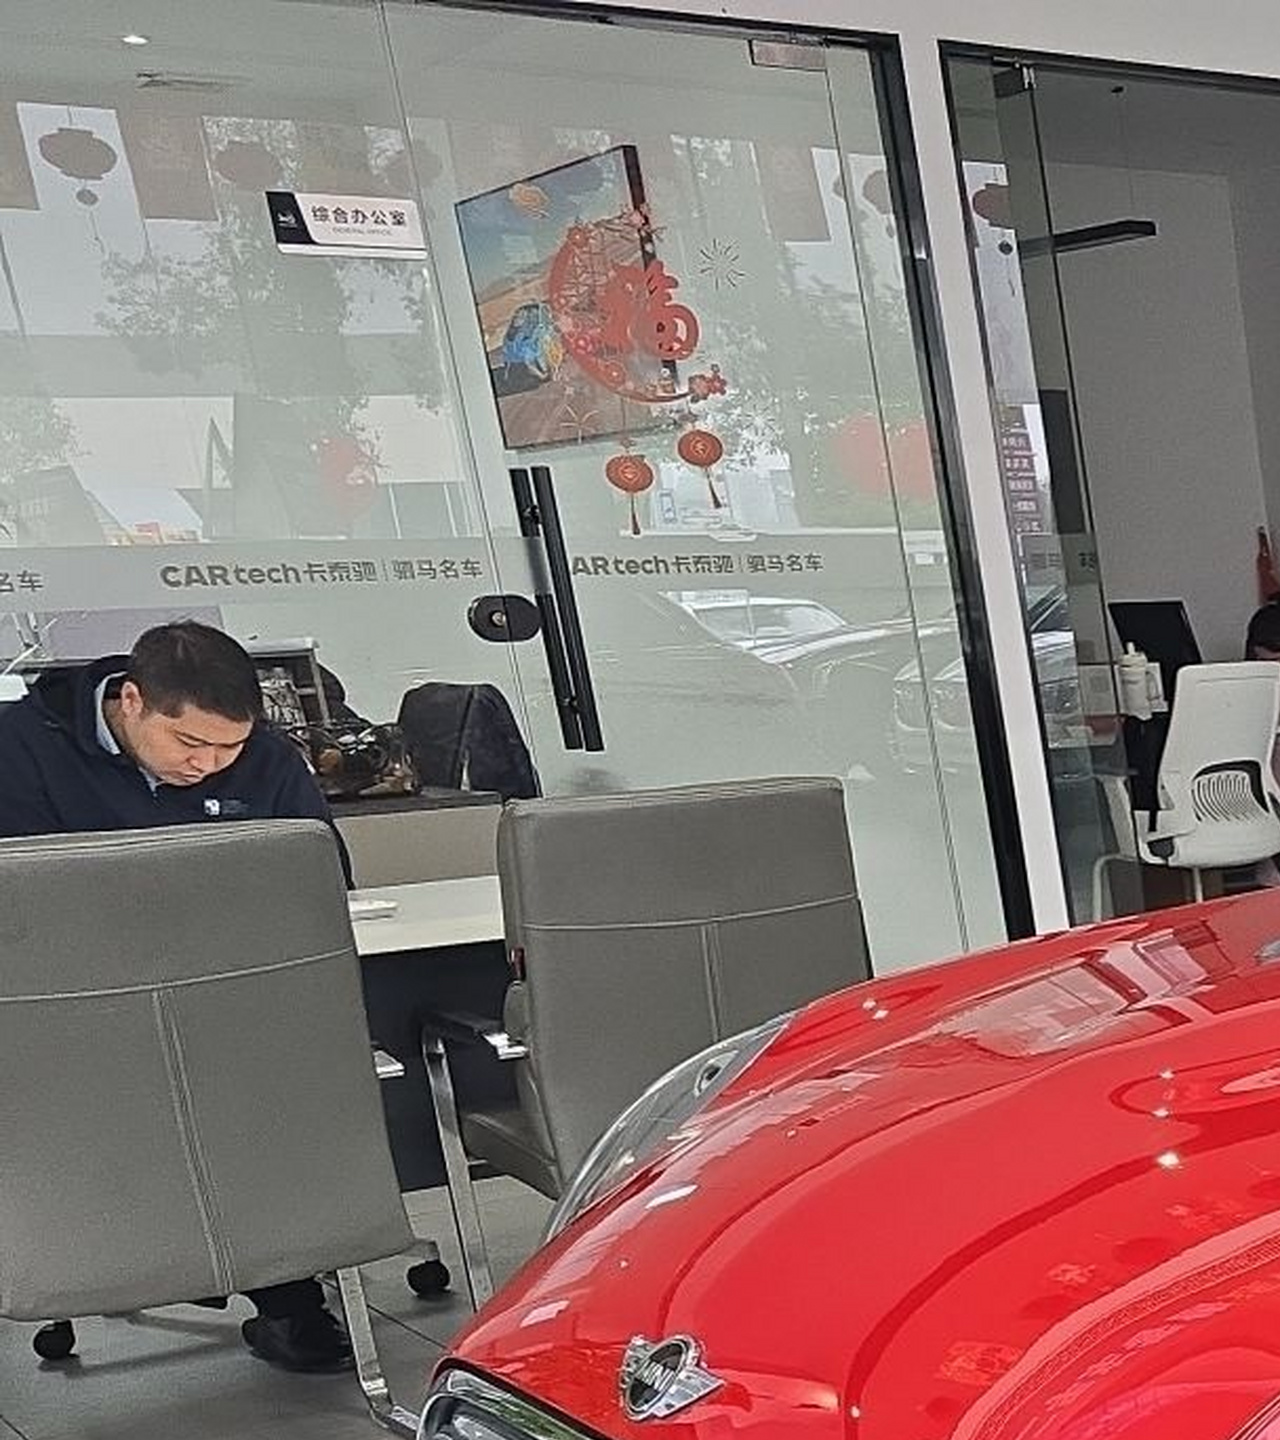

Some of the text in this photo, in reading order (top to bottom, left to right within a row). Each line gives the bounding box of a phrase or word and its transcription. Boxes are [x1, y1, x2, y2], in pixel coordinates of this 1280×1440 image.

[311, 206, 407, 227] 综合办公室
